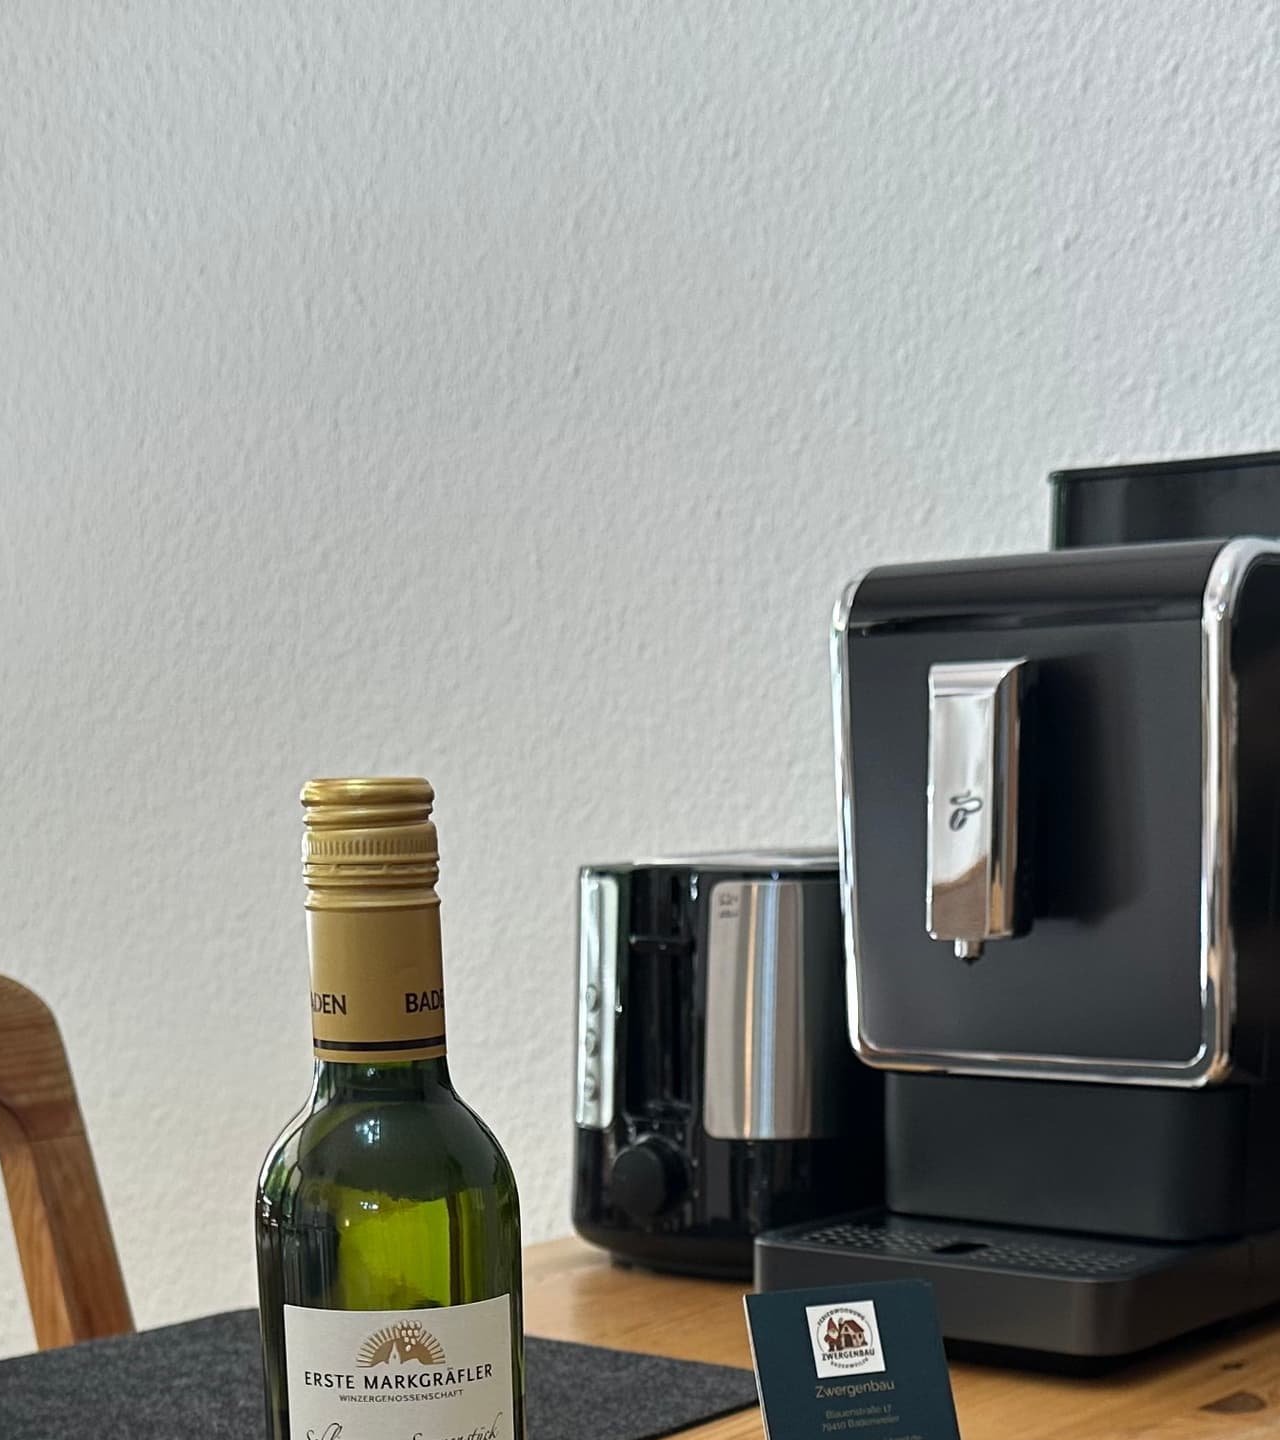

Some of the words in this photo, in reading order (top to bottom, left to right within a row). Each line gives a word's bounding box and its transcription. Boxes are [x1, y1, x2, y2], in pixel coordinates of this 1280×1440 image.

[311, 991, 347, 1015] DEN
[821, 1348, 876, 1361] ZWERGENBAU
[304, 1370, 355, 1390] ERSTE
[364, 1363, 493, 1390] MARKGRÄFLER
[338, 1388, 464, 1403] WINZERGENOSSENSCHAFT
[815, 1380, 895, 1399] Zwergenbau
